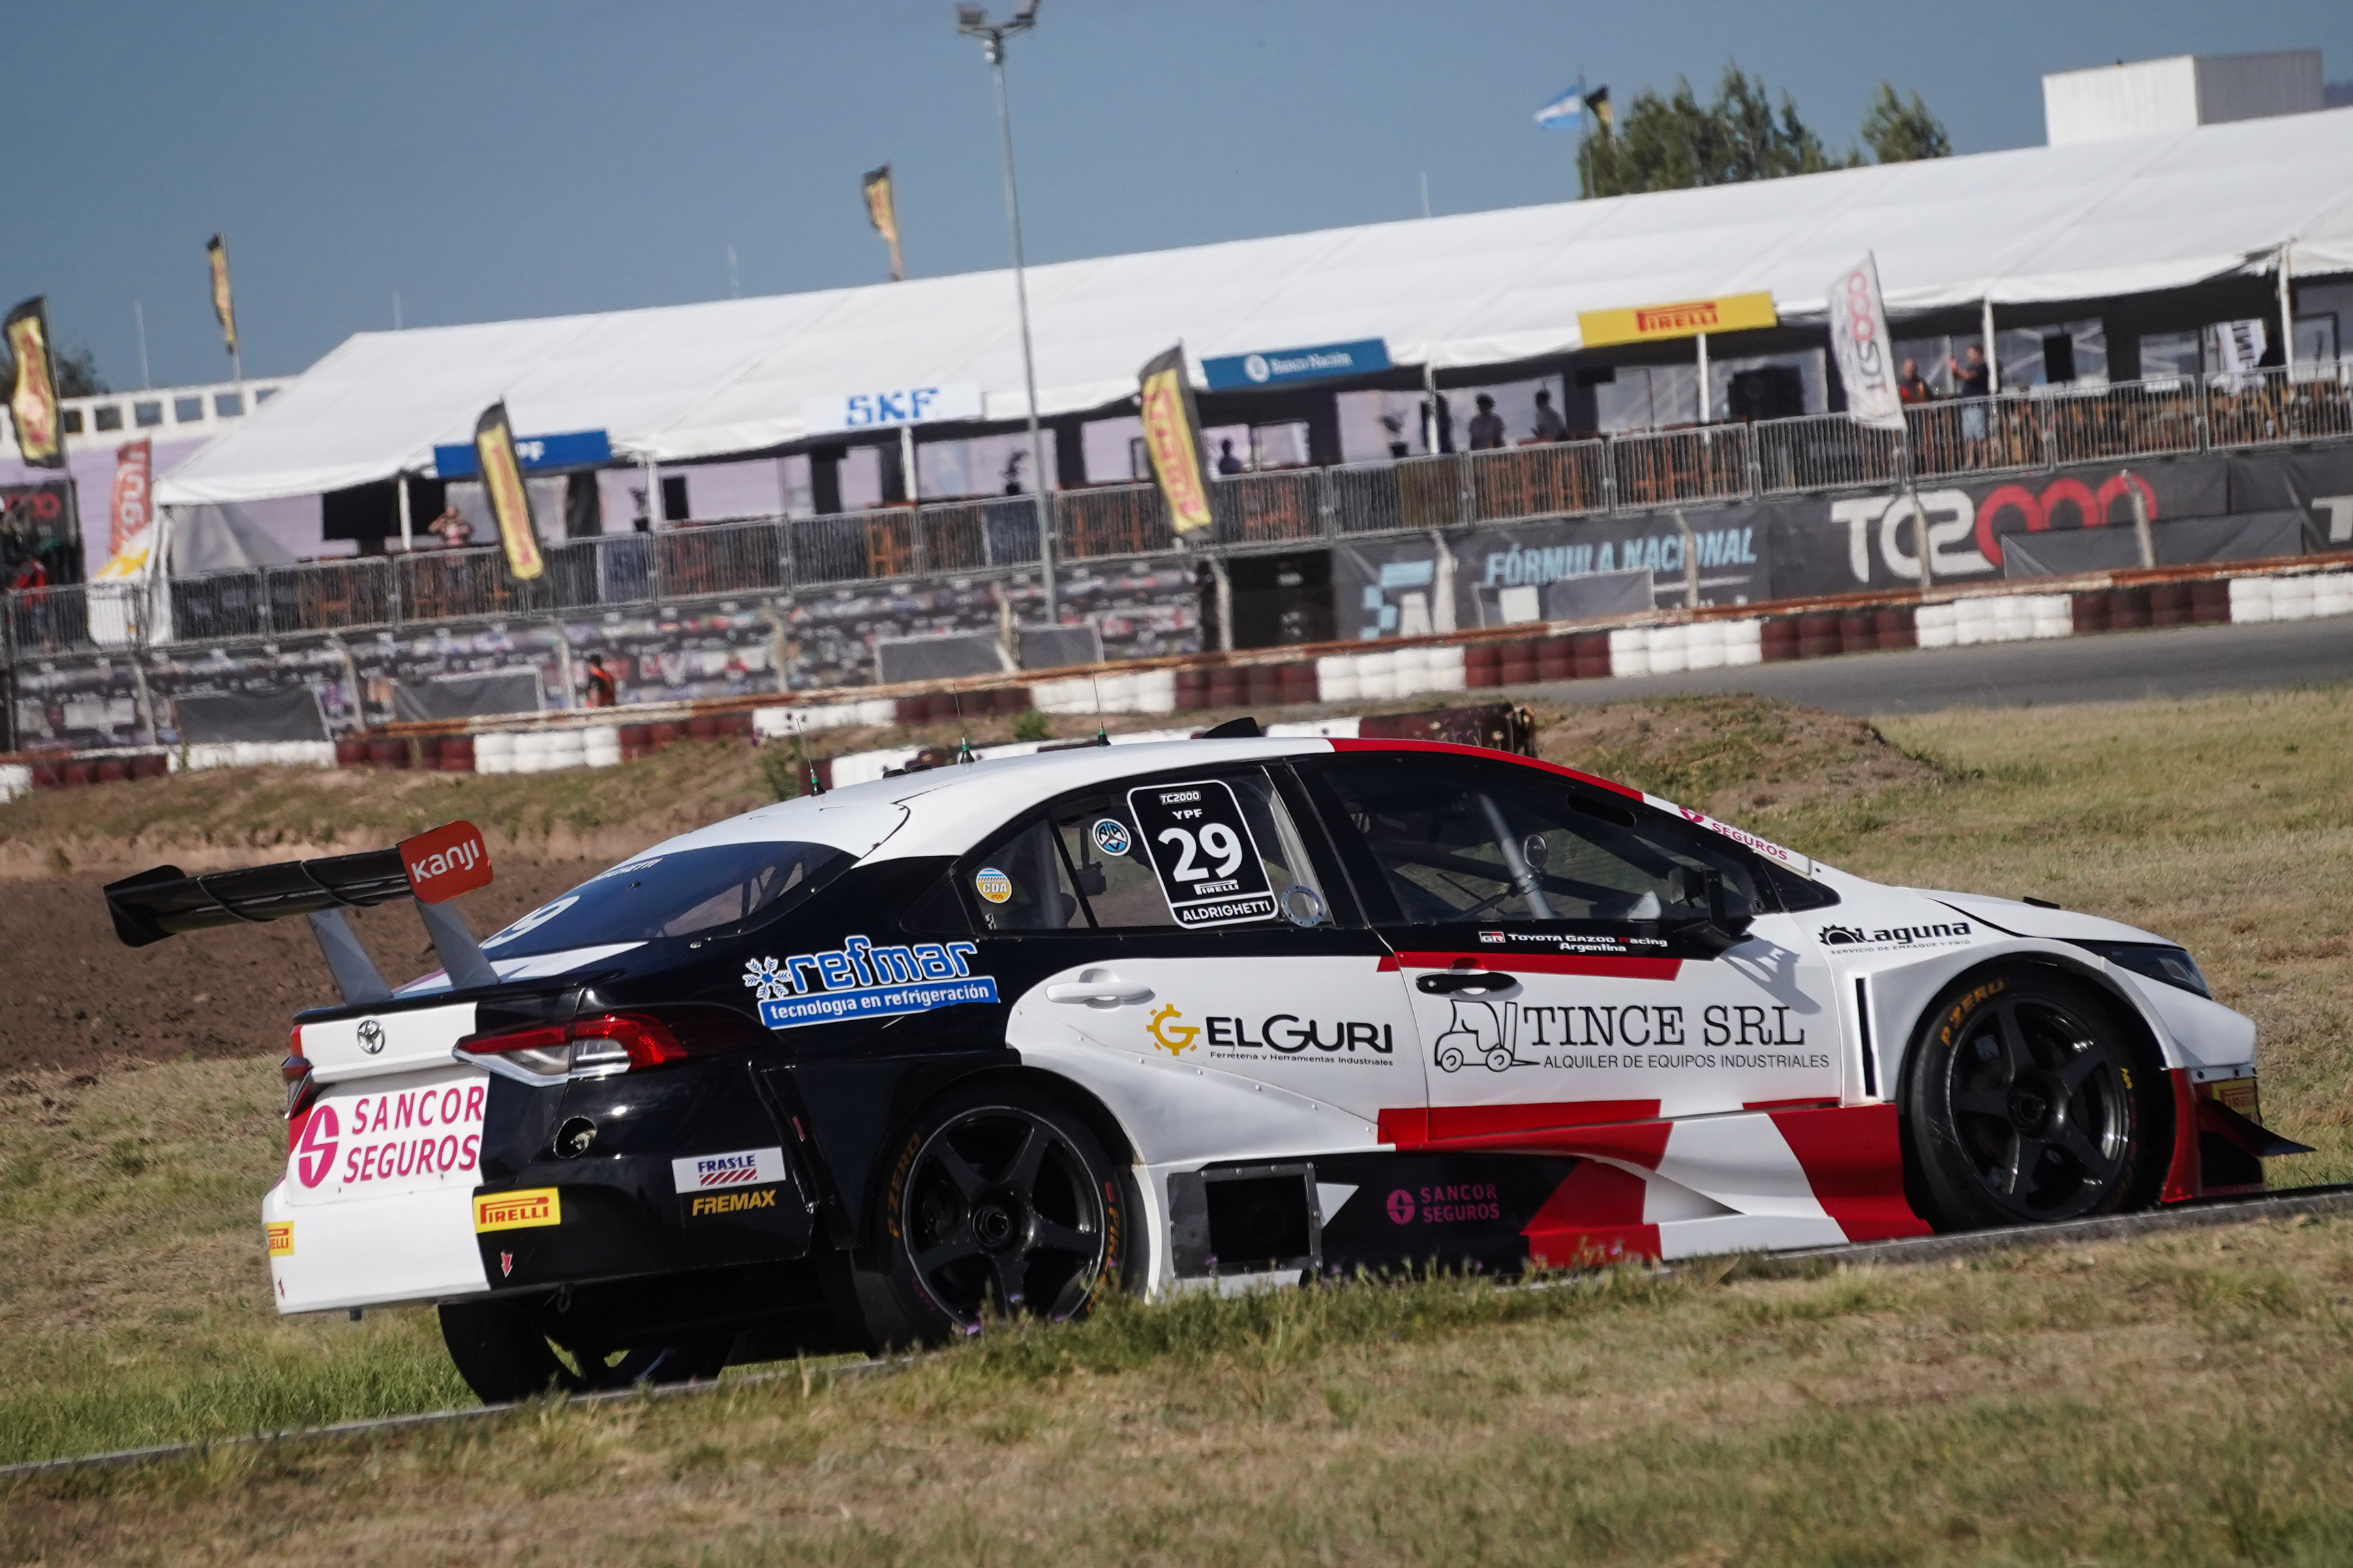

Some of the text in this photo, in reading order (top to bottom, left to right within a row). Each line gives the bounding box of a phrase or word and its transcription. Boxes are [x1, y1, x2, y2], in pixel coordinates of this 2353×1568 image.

[1637, 302, 1718, 332] PIRELLI
[847, 386, 938, 426] SKF
[1622, 526, 1758, 573] NACINAL
[1159, 790, 1202, 805] TC2000
[1172, 809, 1202, 820] YPF
[1158, 823, 1243, 882] 29
[1712, 823, 1788, 861] SEGUROS
[982, 882, 1008, 893] CDA
[1194, 879, 1239, 895] PIRELLI
[1182, 900, 1271, 922] ALDRIGHETTI
[1482, 934, 1668, 947] GR TOYOTA GAZOO Racing
[1855, 921, 1973, 944] Laguna
[1560, 942, 1627, 953] Argentina
[1831, 947, 1874, 955] SERVICIO
[1893, 942, 1938, 951] EMPAQUE
[785, 934, 977, 994] refmar
[861, 996, 881, 1009] en
[884, 984, 990, 1006] refrigeración
[1941, 979, 2004, 1047] P ZERO
[1523, 1005, 1805, 1047] TINCE SRL
[1270, 1054, 1335, 1064] Herramientas
[1338, 1057, 1393, 1066] Industriales
[1544, 1055, 1830, 1069] ALQUILER DE EQUIPOS INDUSTRIALES
[352, 1086, 485, 1135] SANCOR
[343, 1135, 480, 1183] SEGUROS
[692, 1189, 776, 1216] FREMAX
[1421, 1183, 1498, 1203] SANCOR
[480, 1197, 549, 1225] PIRELLI
[1423, 1203, 1500, 1223] SEGUROS
